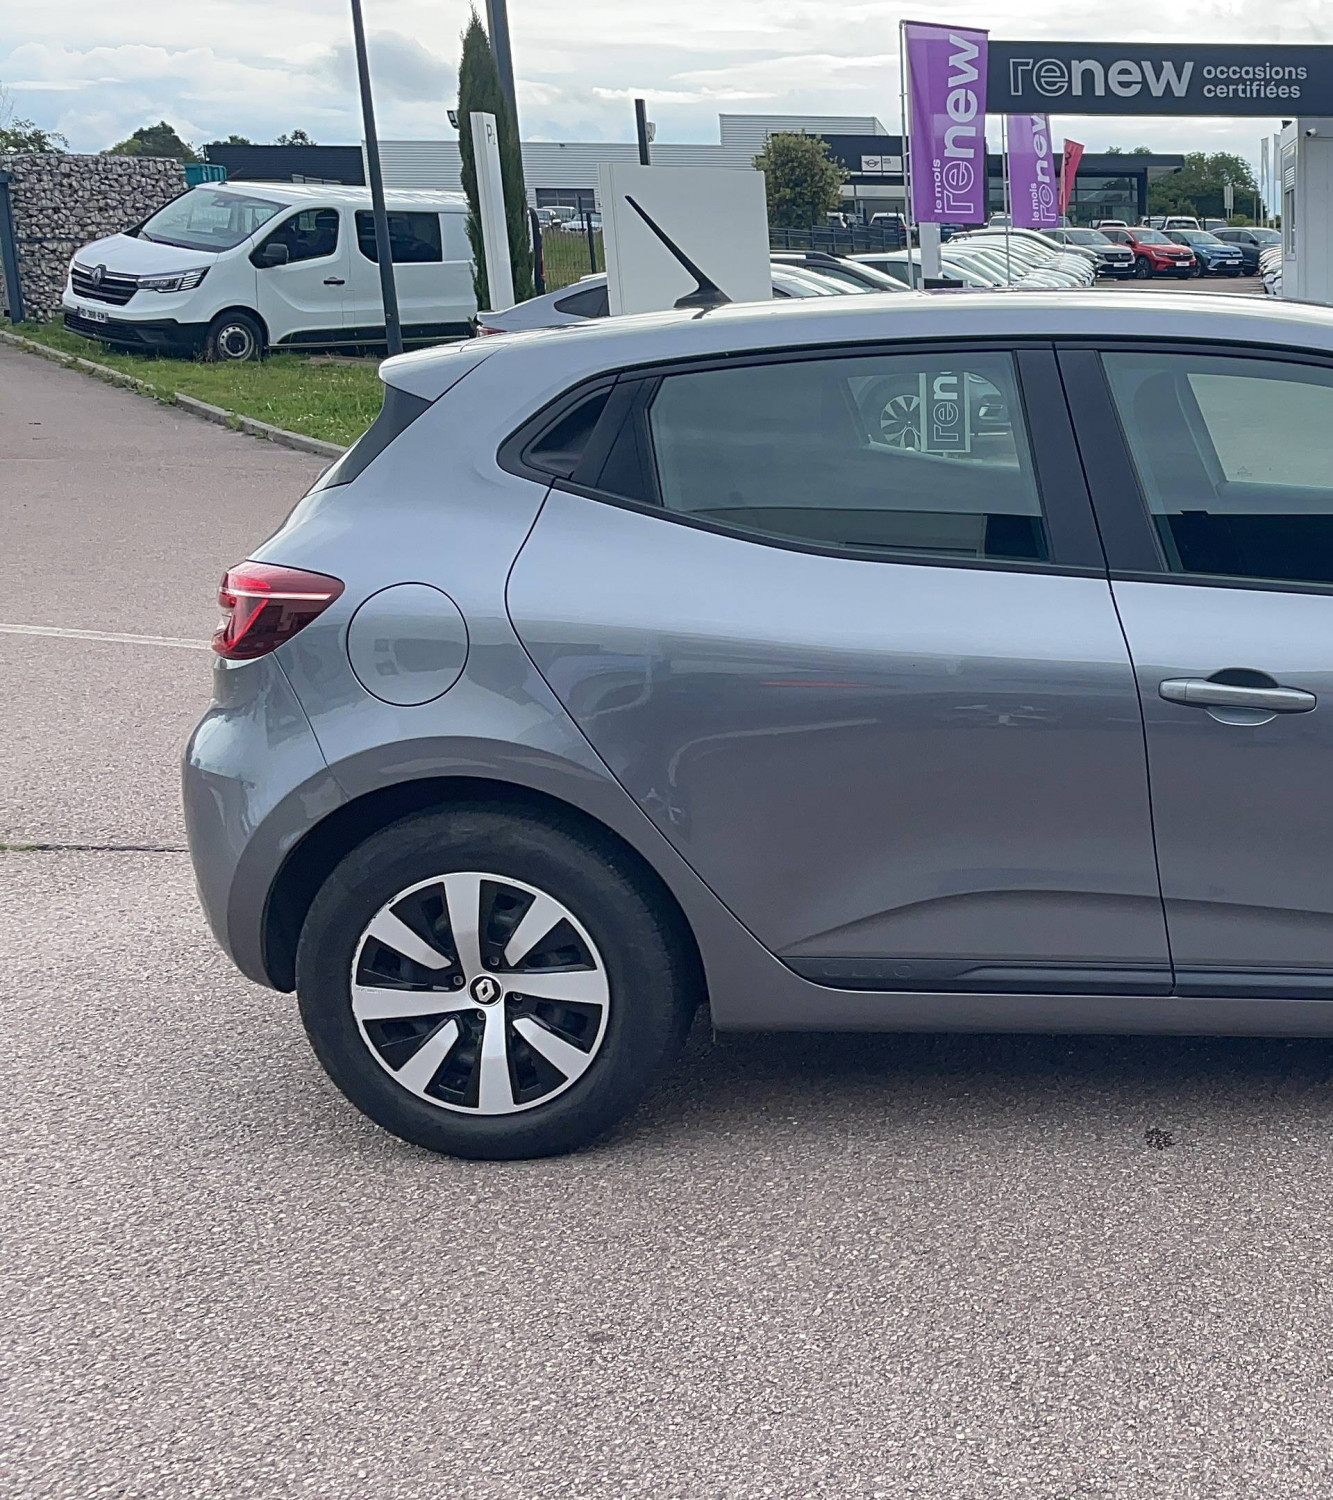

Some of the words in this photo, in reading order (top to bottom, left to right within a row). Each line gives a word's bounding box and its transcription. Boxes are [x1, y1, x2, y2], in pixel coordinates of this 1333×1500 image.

[1009, 58, 1195, 97] renew
[1203, 62, 1307, 79] occasions
[1203, 81, 1301, 98] certifiées
[943, 33, 979, 214] renew
[932, 158, 942, 198] mois
[934, 200, 942, 213] le
[1029, 182, 1039, 210] mois
[933, 371, 959, 442] ren
